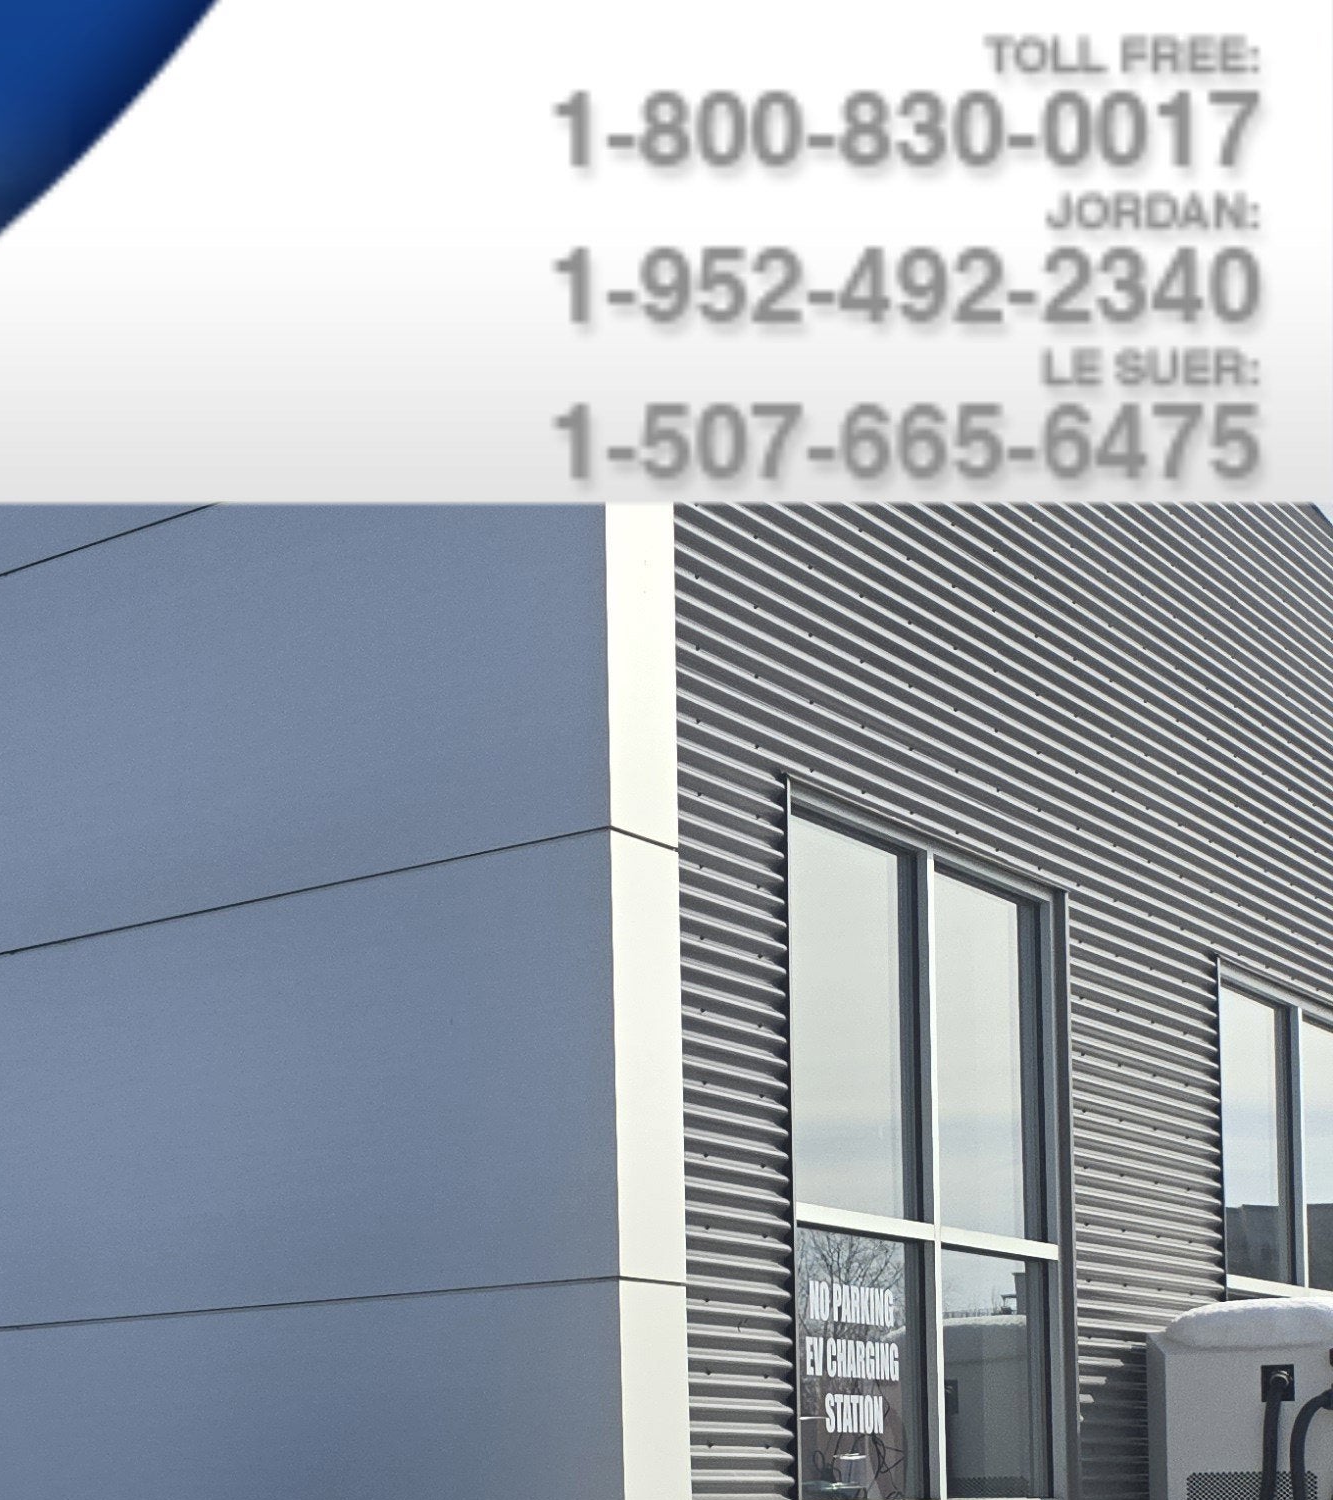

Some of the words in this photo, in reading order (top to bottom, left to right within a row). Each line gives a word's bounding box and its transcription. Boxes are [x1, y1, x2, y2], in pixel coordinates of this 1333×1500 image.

[809, 1280, 831, 1322] NO
[833, 1283, 895, 1328] PARKING
[805, 1336, 824, 1377] EV
[826, 1337, 900, 1382] CHARGING
[824, 1392, 884, 1435] STATION
